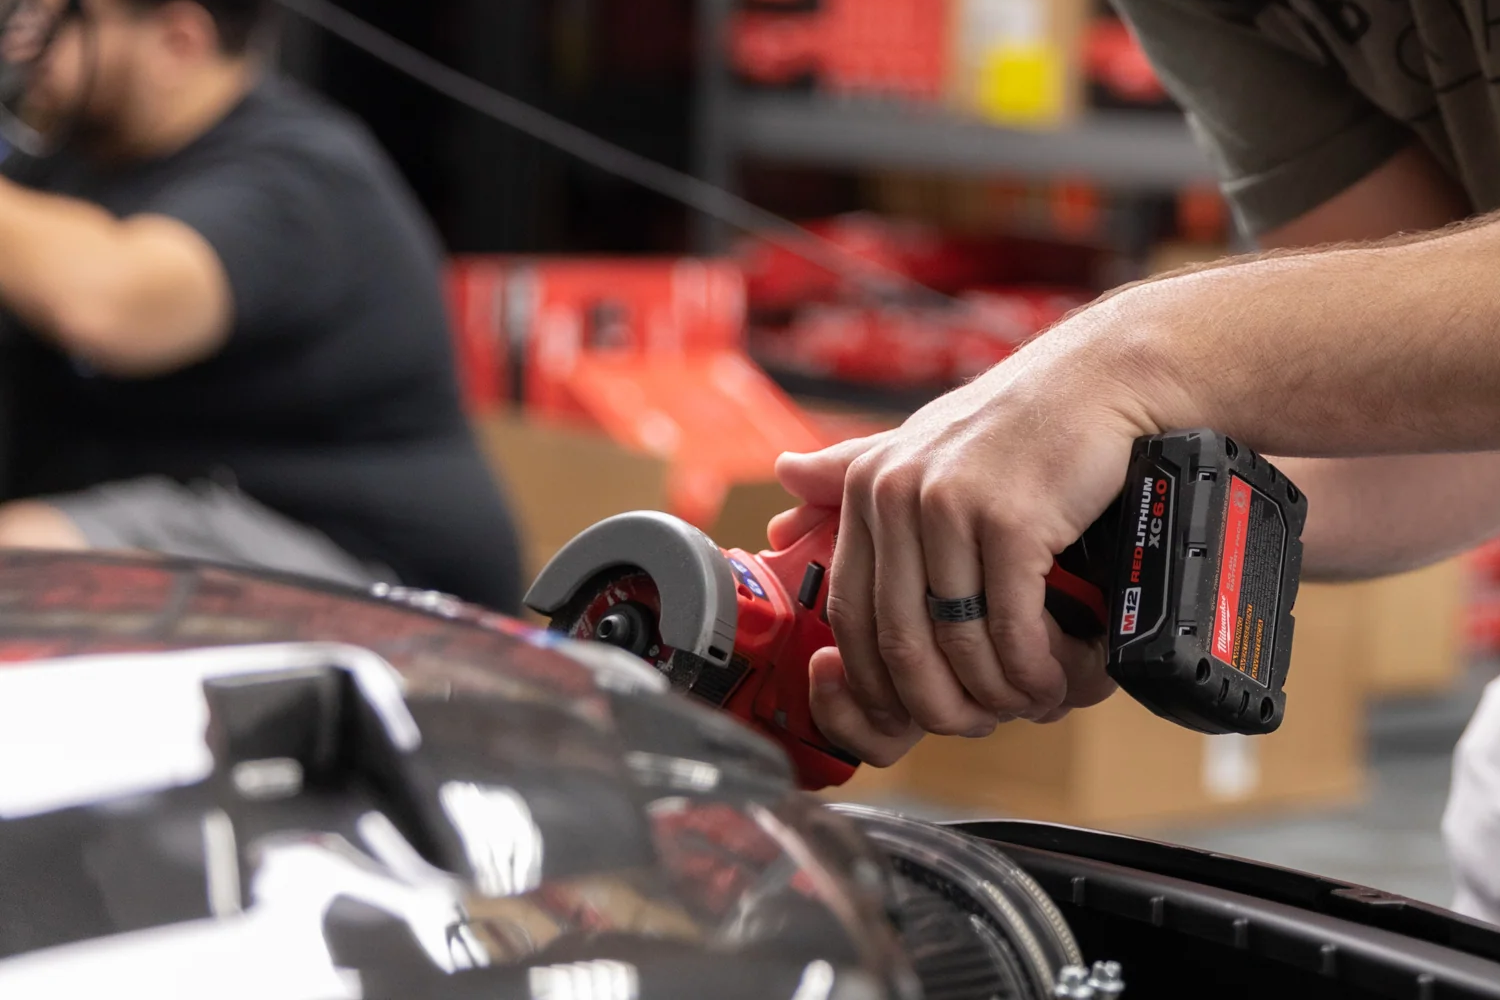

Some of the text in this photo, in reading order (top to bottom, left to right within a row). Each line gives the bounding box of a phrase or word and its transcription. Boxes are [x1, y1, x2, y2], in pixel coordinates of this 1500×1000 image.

[1130, 477, 1154, 583] REDLITHIUM
[1148, 479, 1168, 549] XC6.0
[1123, 589, 1139, 632] M12
[1217, 594, 1228, 654] Milwaukee
[1233, 615, 1243, 658] WARNING
